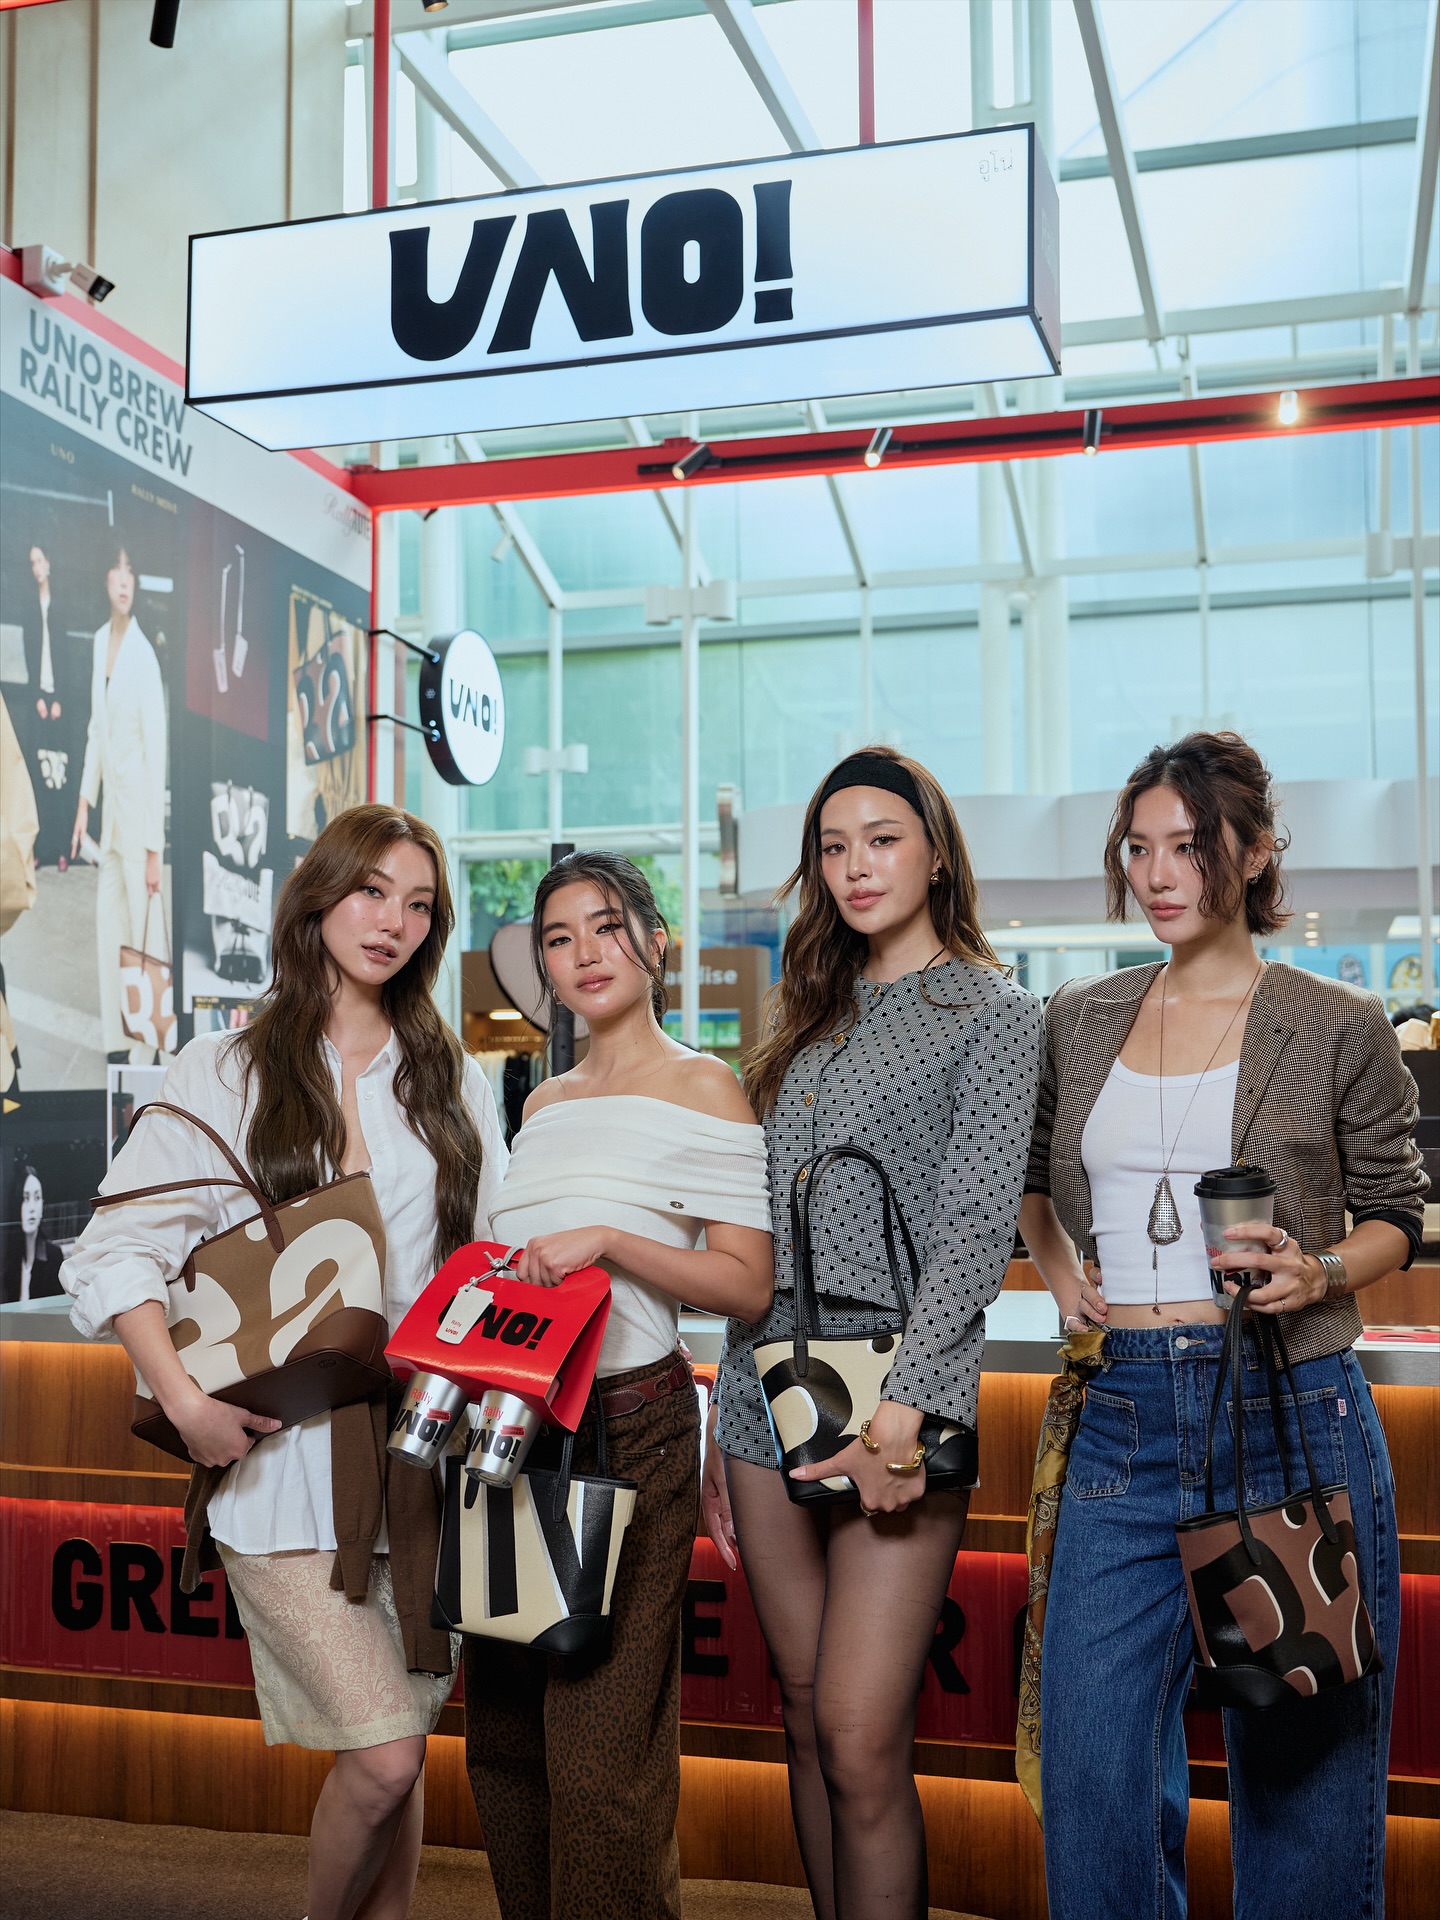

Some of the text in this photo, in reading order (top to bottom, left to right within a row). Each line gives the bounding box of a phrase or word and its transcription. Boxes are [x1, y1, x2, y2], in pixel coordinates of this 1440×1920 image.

[389, 179, 793, 361] UNO!
[30, 308, 186, 434] UNO BREW
[20, 347, 193, 477] RALLY CREW
[450, 679, 497, 735] UNO!
[437, 1294, 553, 1350] NO!
[411, 1387, 433, 1405] Rally
[483, 1405, 504, 1421] Rally
